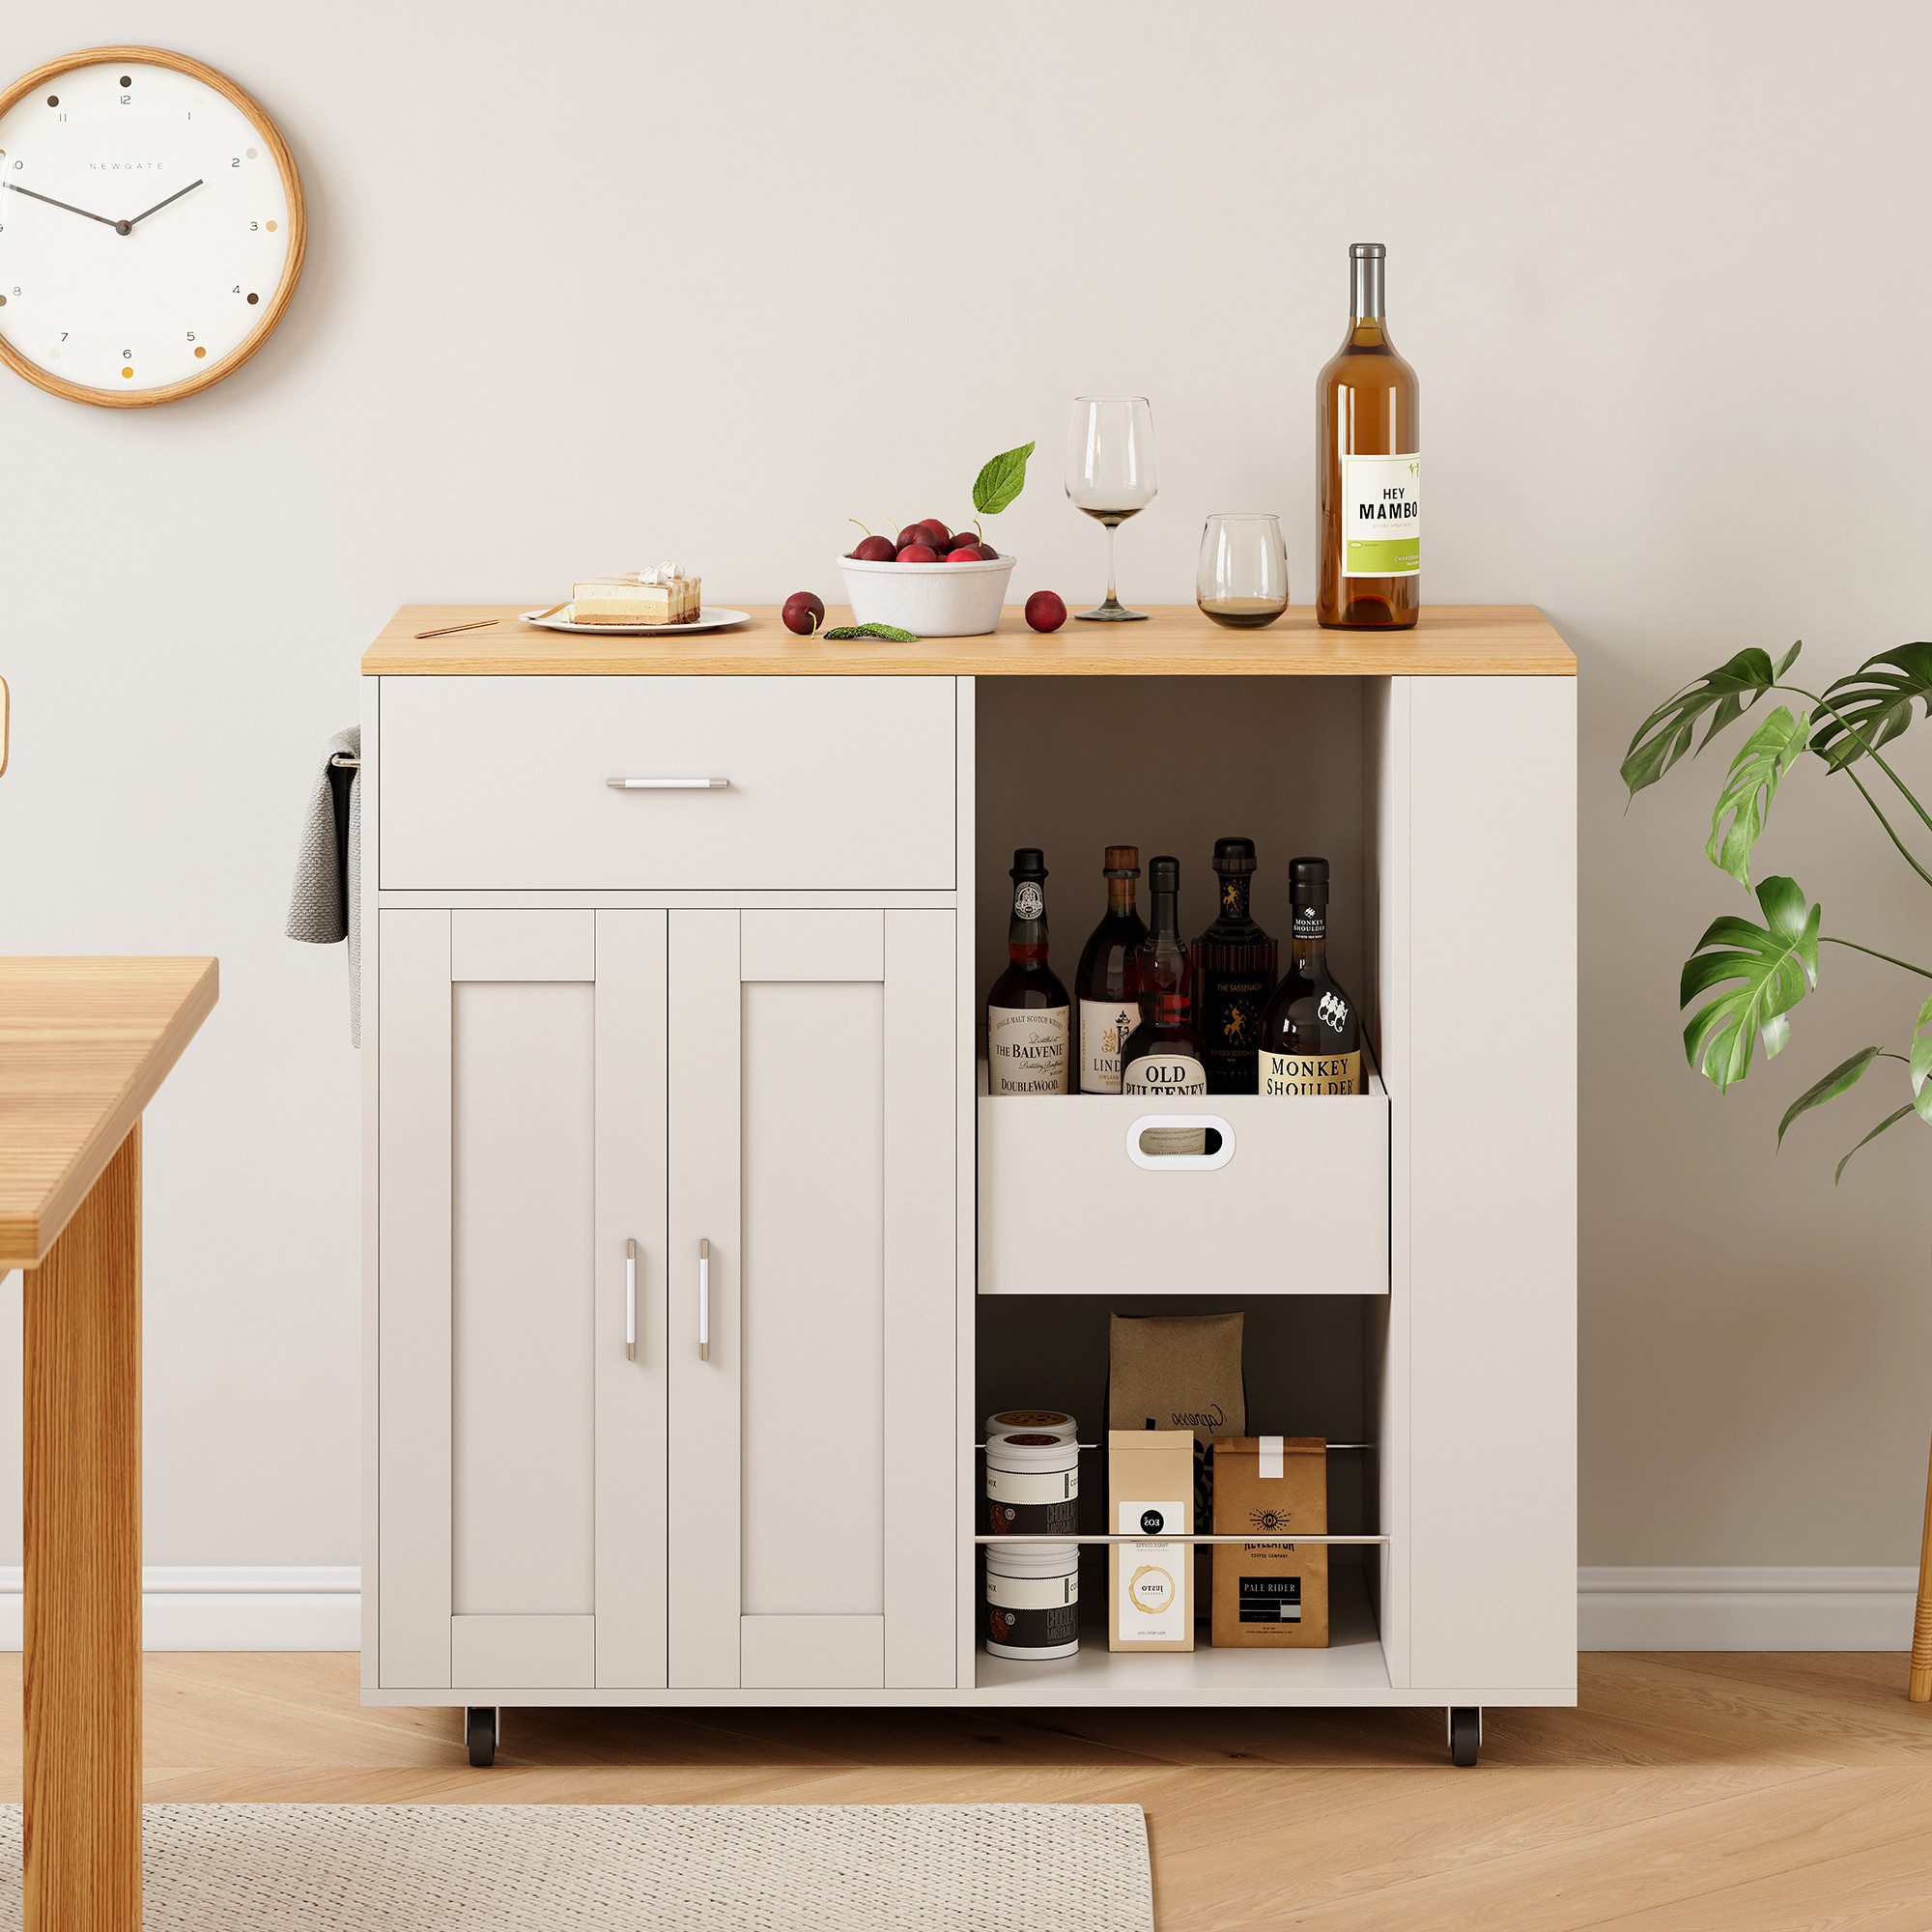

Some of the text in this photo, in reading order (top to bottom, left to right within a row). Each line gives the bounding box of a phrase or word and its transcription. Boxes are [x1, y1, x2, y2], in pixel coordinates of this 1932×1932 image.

[120, 95, 131, 104] 12
[59, 113, 67, 122] 11
[232, 158, 241, 167] 2
[250, 221, 259, 231] 3
[13, 287, 21, 296] 8
[232, 285, 241, 294] 4
[61, 332, 69, 342] 7
[186, 331, 195, 341] 5
[123, 349, 132, 358] 6
[1383, 488, 1405, 499] HEY
[1359, 501, 1418, 520] MAMBO
[1010, 1015, 1025, 1024] MALT
[1027, 1015, 1048, 1024] SCOTCH
[996, 1043, 1064, 1058] THE BALVENIE
[1272, 1058, 1349, 1077] MONKEY
[1146, 1065, 1185, 1083] OLD
[1001, 1078, 1058, 1092] DOUBLEWOOD
[1244, 1583, 1295, 1592] PALE RIDER
